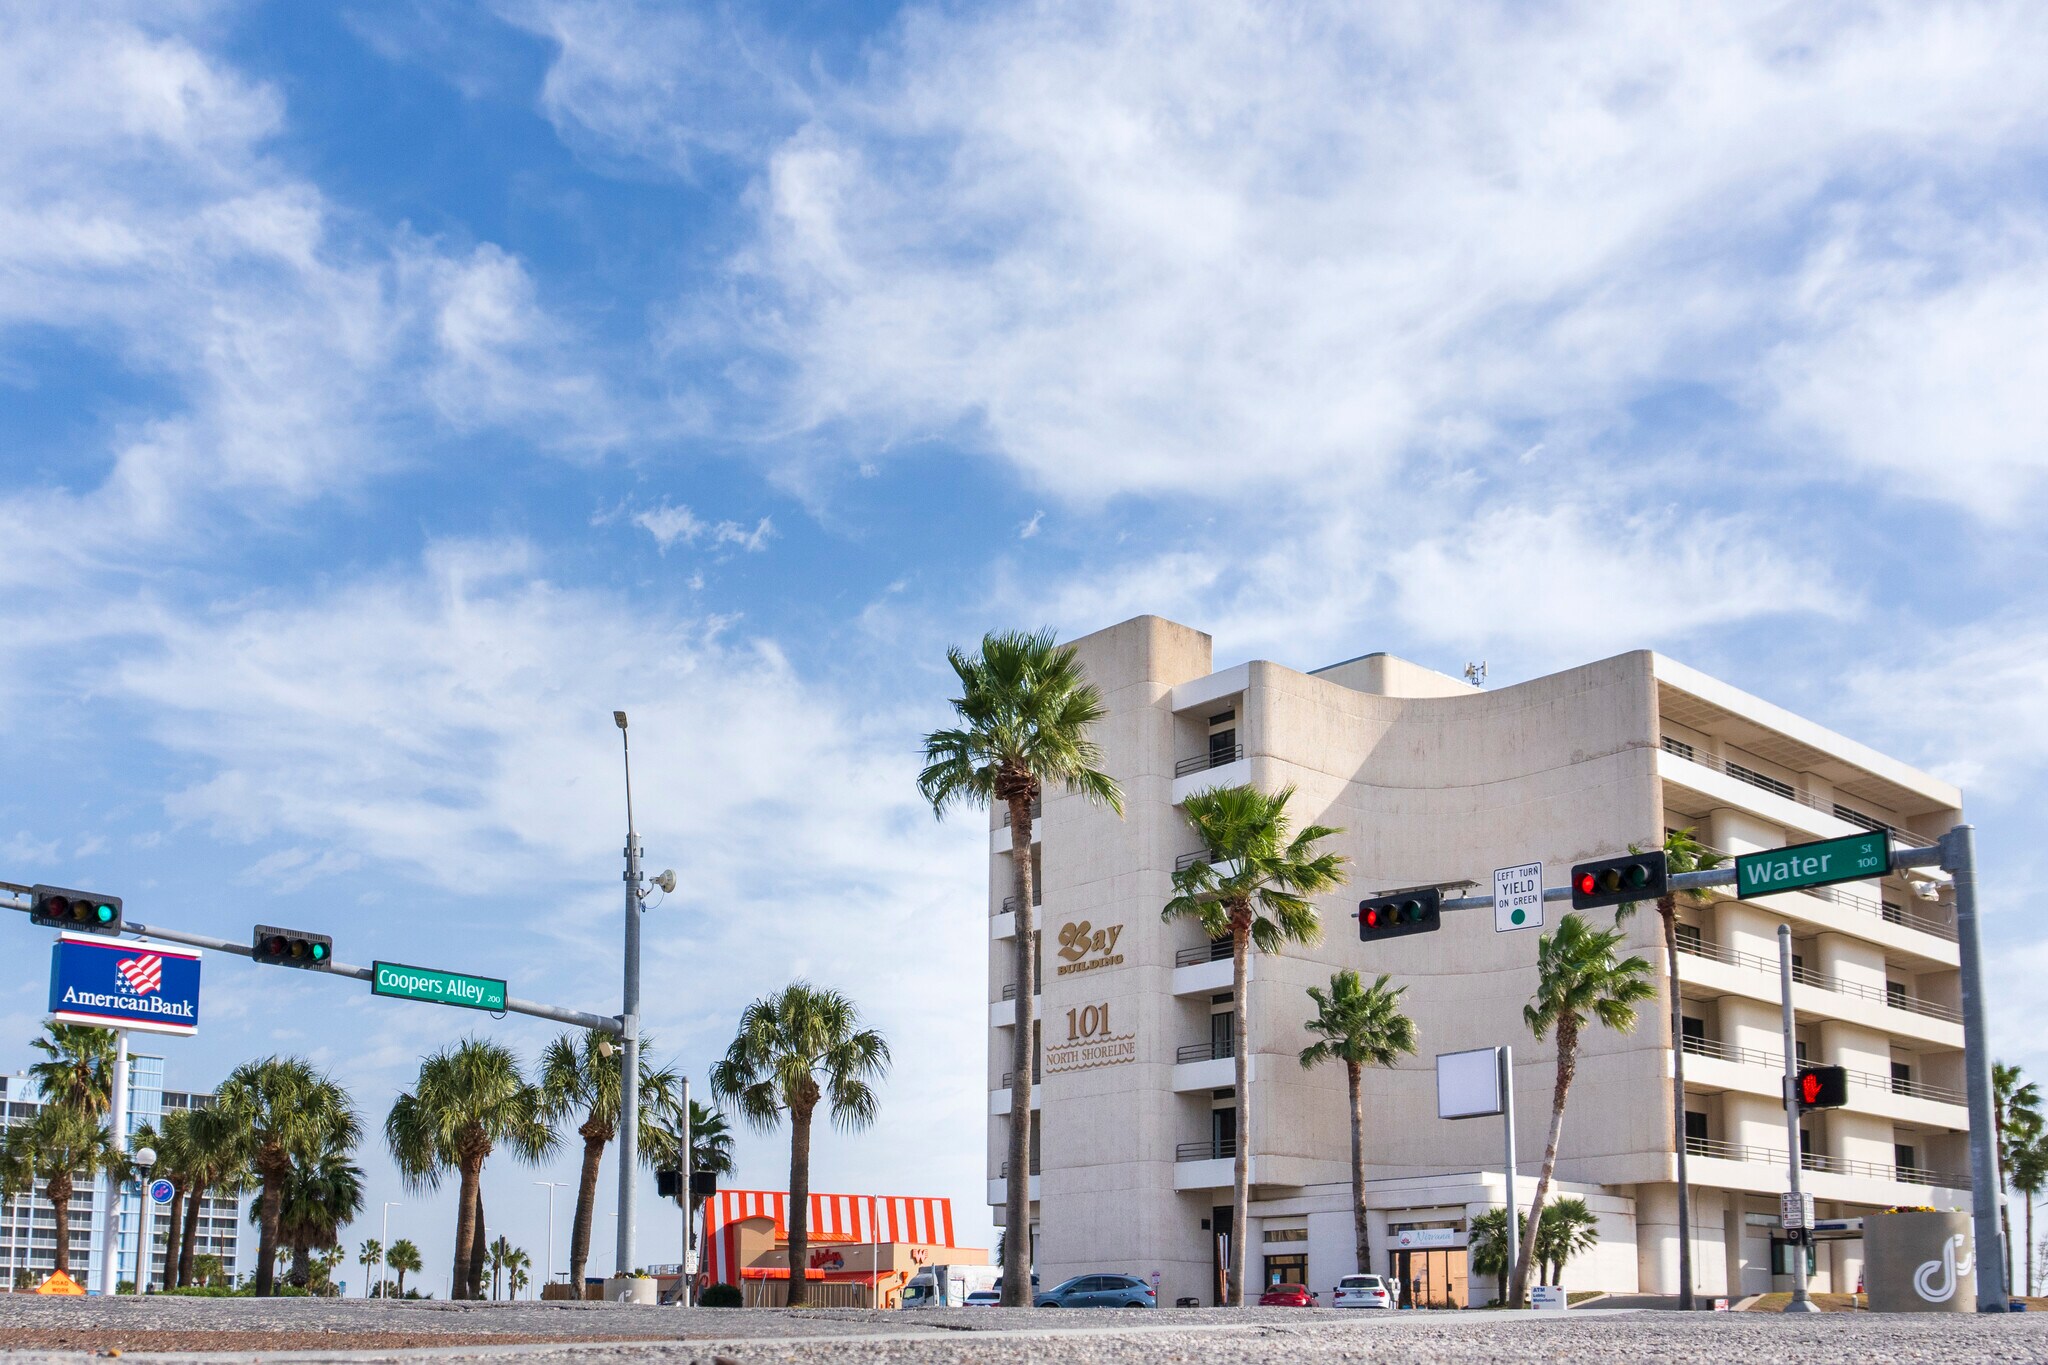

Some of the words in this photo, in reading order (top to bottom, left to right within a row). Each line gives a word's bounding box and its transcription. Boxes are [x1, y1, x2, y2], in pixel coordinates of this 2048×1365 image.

[1497, 871, 1514, 881] LEFT
[1519, 866, 1539, 877] TURN
[1747, 853, 1832, 885] Water
[1861, 843, 1873, 854] St
[1857, 856, 1878, 868] 100
[1502, 880, 1534, 895] YIELD
[1499, 899, 1509, 908] ON
[1514, 895, 1538, 906] GREEN
[1058, 920, 1124, 962] Bay
[1057, 954, 1124, 976] BUILDING
[379, 969, 443, 994] Coopers
[446, 979, 485, 1003] Alley
[487, 995, 501, 1004] 200
[1066, 1002, 1112, 1041] 101
[1046, 1050, 1079, 1066] NORTH
[1082, 1042, 1136, 1061] SHORELINE
